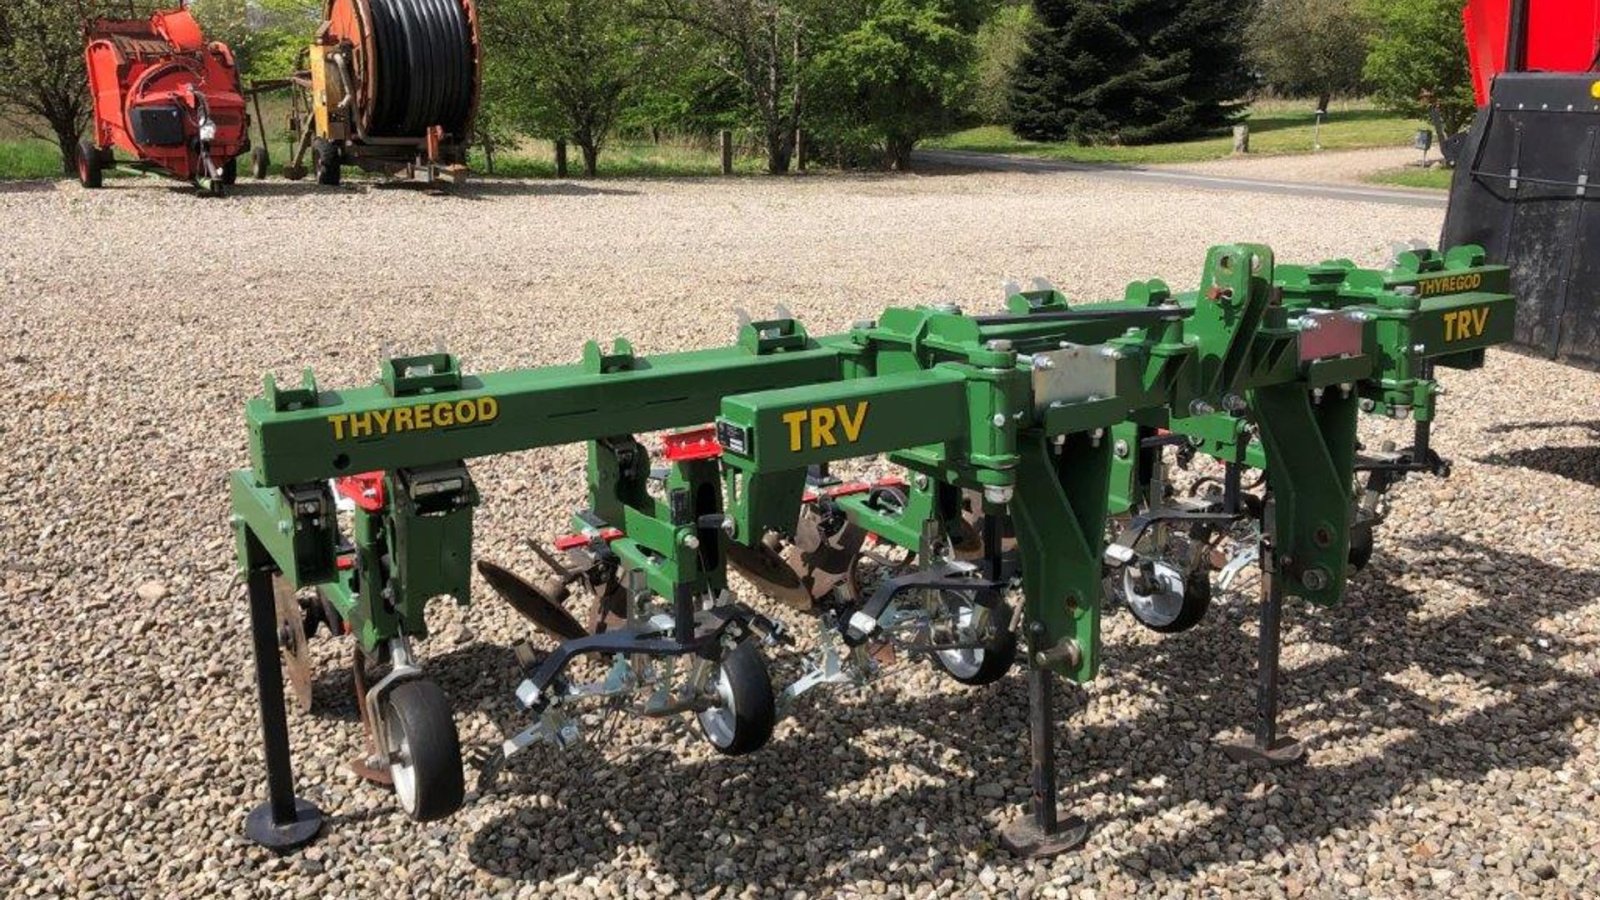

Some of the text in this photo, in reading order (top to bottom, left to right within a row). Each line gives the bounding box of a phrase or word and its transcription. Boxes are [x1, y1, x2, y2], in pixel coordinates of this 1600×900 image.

[1419, 273, 1481, 294] THYREGOD
[1443, 307, 1490, 341] TRV
[328, 397, 498, 439] THYREGOD
[782, 402, 868, 452] TRV
